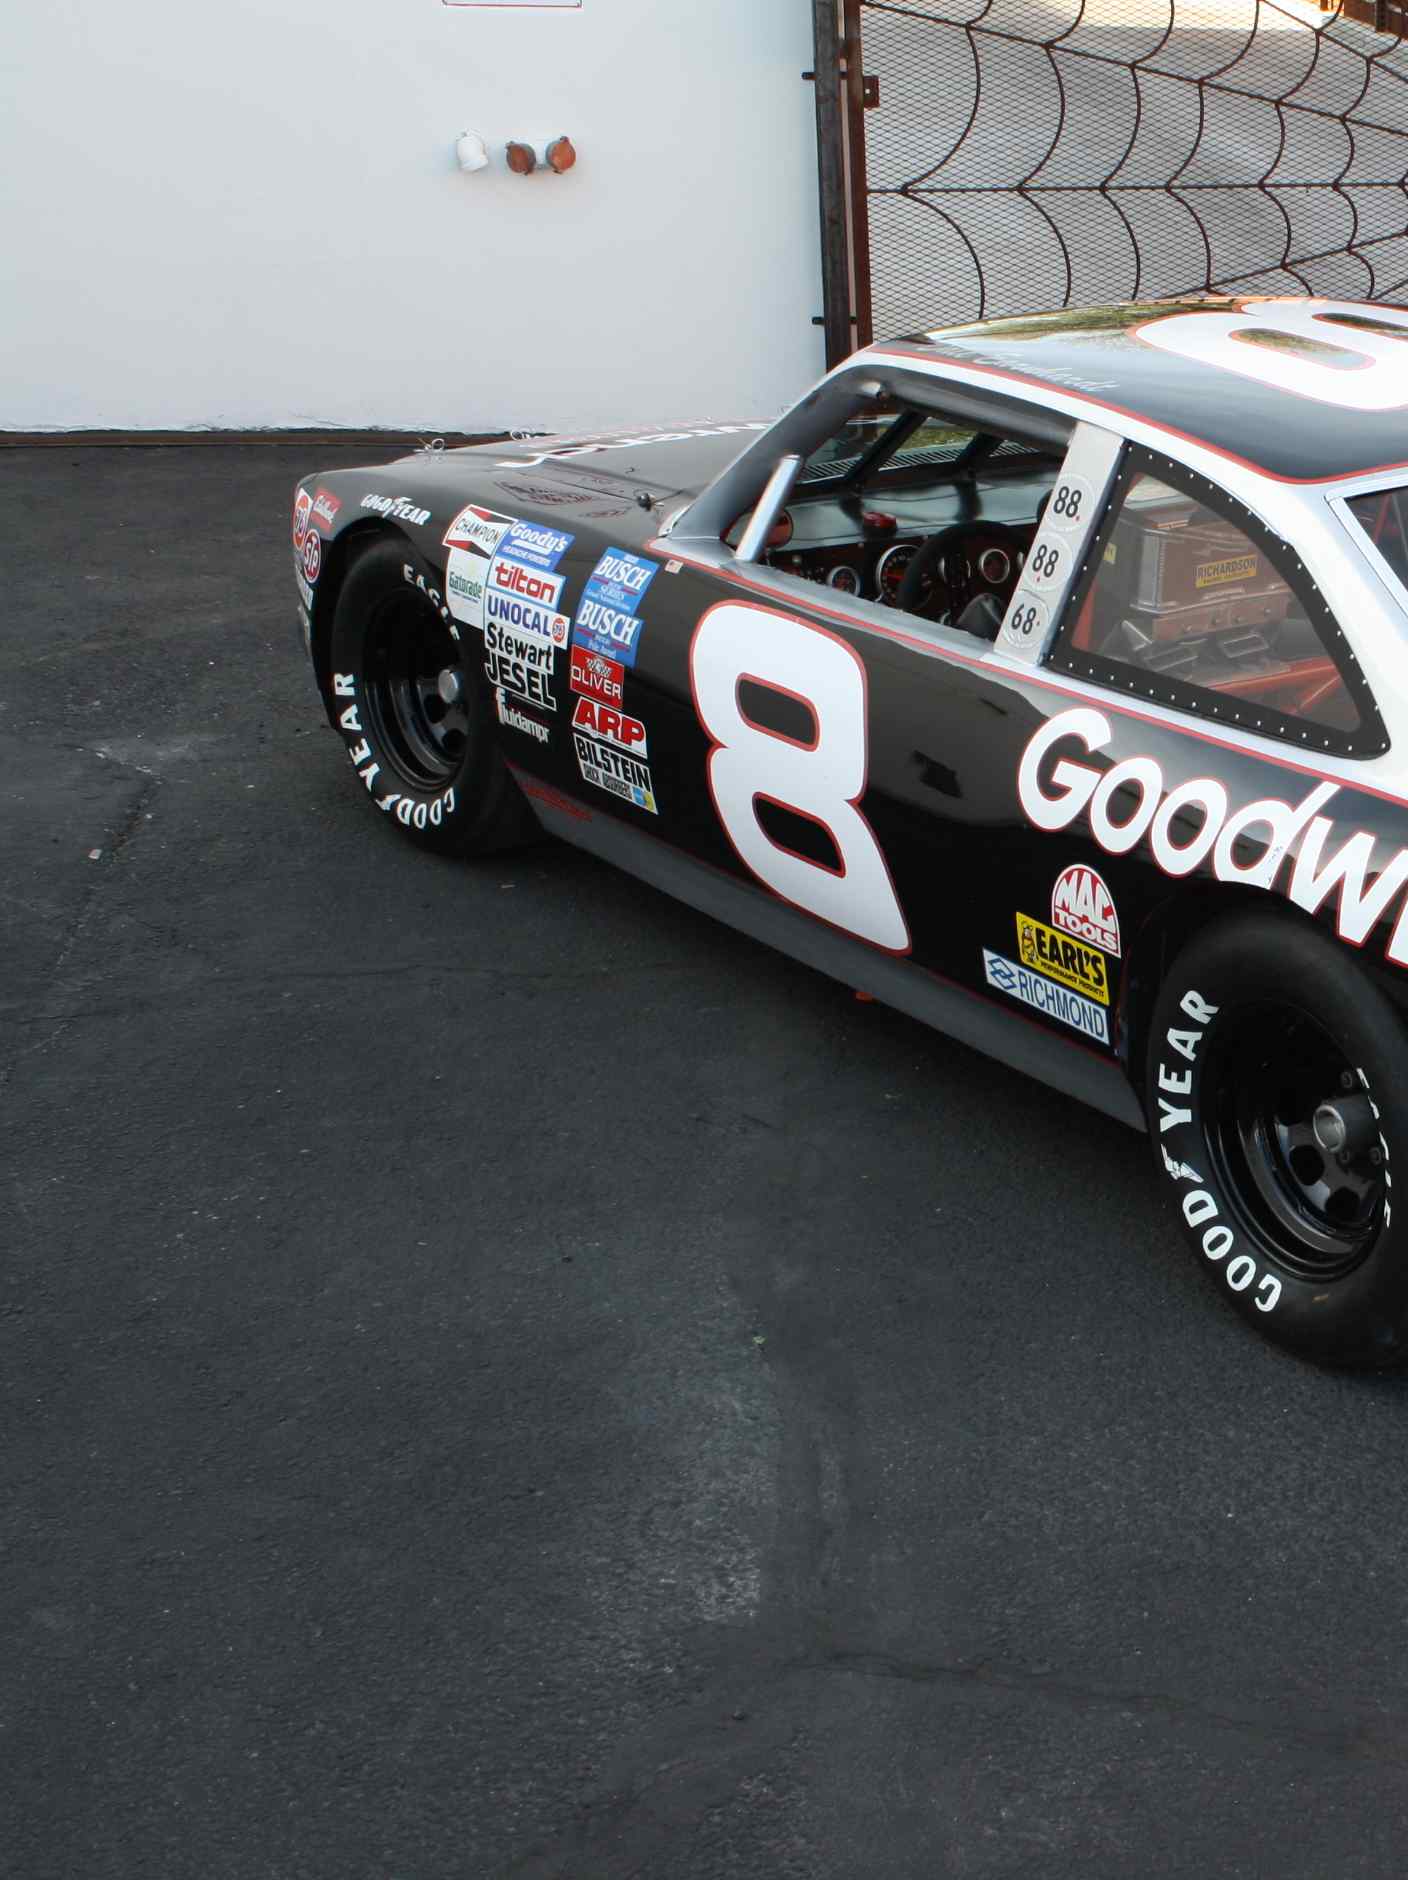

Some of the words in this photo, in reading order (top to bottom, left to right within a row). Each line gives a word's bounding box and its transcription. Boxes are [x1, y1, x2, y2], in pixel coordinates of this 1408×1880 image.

[1053, 486, 1082, 518] 88
[455, 518, 500, 545] CHAMPION
[510, 523, 568, 552] Goody's
[304, 535, 319, 574] STP
[594, 555, 652, 591] BUSCH
[1032, 544, 1059, 577] 88
[1197, 558, 1257, 579] RICHARDSON
[449, 571, 483, 600] Gatorade
[495, 562, 555, 603] tilton
[488, 595, 551, 637] UNOCAL
[576, 599, 639, 647] BUSCH
[1011, 603, 1037, 635] 68
[486, 621, 552, 672] Stewart
[484, 649, 557, 711] JESEL
[570, 665, 622, 699] OLIVER
[333, 673, 380, 793] YEAR
[573, 698, 646, 747] ARP
[575, 737, 652, 793] BILSTEIN
[690, 599, 912, 957] 8
[1055, 869, 1117, 935] MAC
[1054, 906, 1117, 951] TOOLS
[1035, 927, 1105, 987] EARL'S
[1018, 970, 1105, 1039] RICHMOND
[1157, 989, 1220, 1133] YEAR
